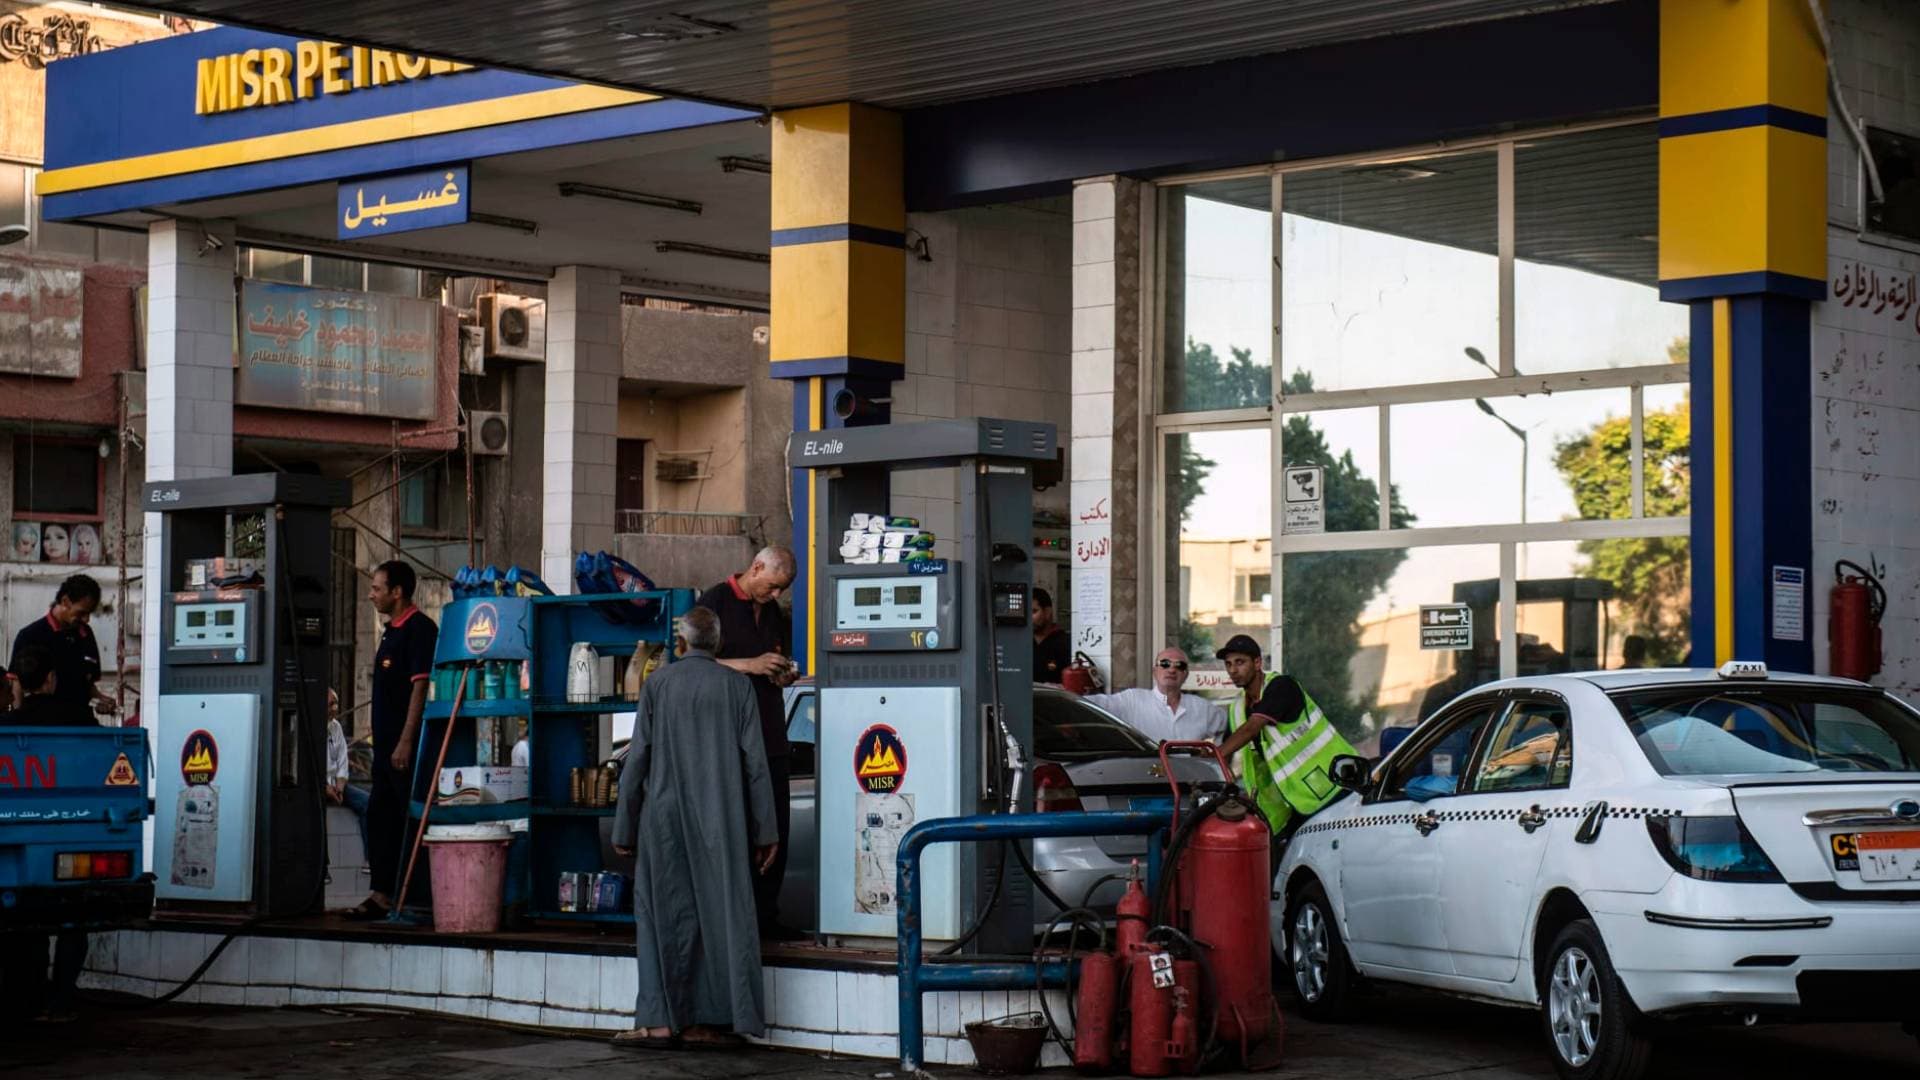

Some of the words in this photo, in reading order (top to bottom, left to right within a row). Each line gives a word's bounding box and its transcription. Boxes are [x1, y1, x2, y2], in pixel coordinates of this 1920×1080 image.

[195, 47, 293, 115] MISR
[344, 172, 460, 230] غسيل
[804, 439, 843, 456] EL-nile
[1080, 498, 1108, 523] مكتب
[1424, 629, 1454, 637] EMERGENCY
[1735, 664, 1762, 673] TAXI
[189, 772, 209, 784] MISR
[868, 777, 895, 790] MISR
